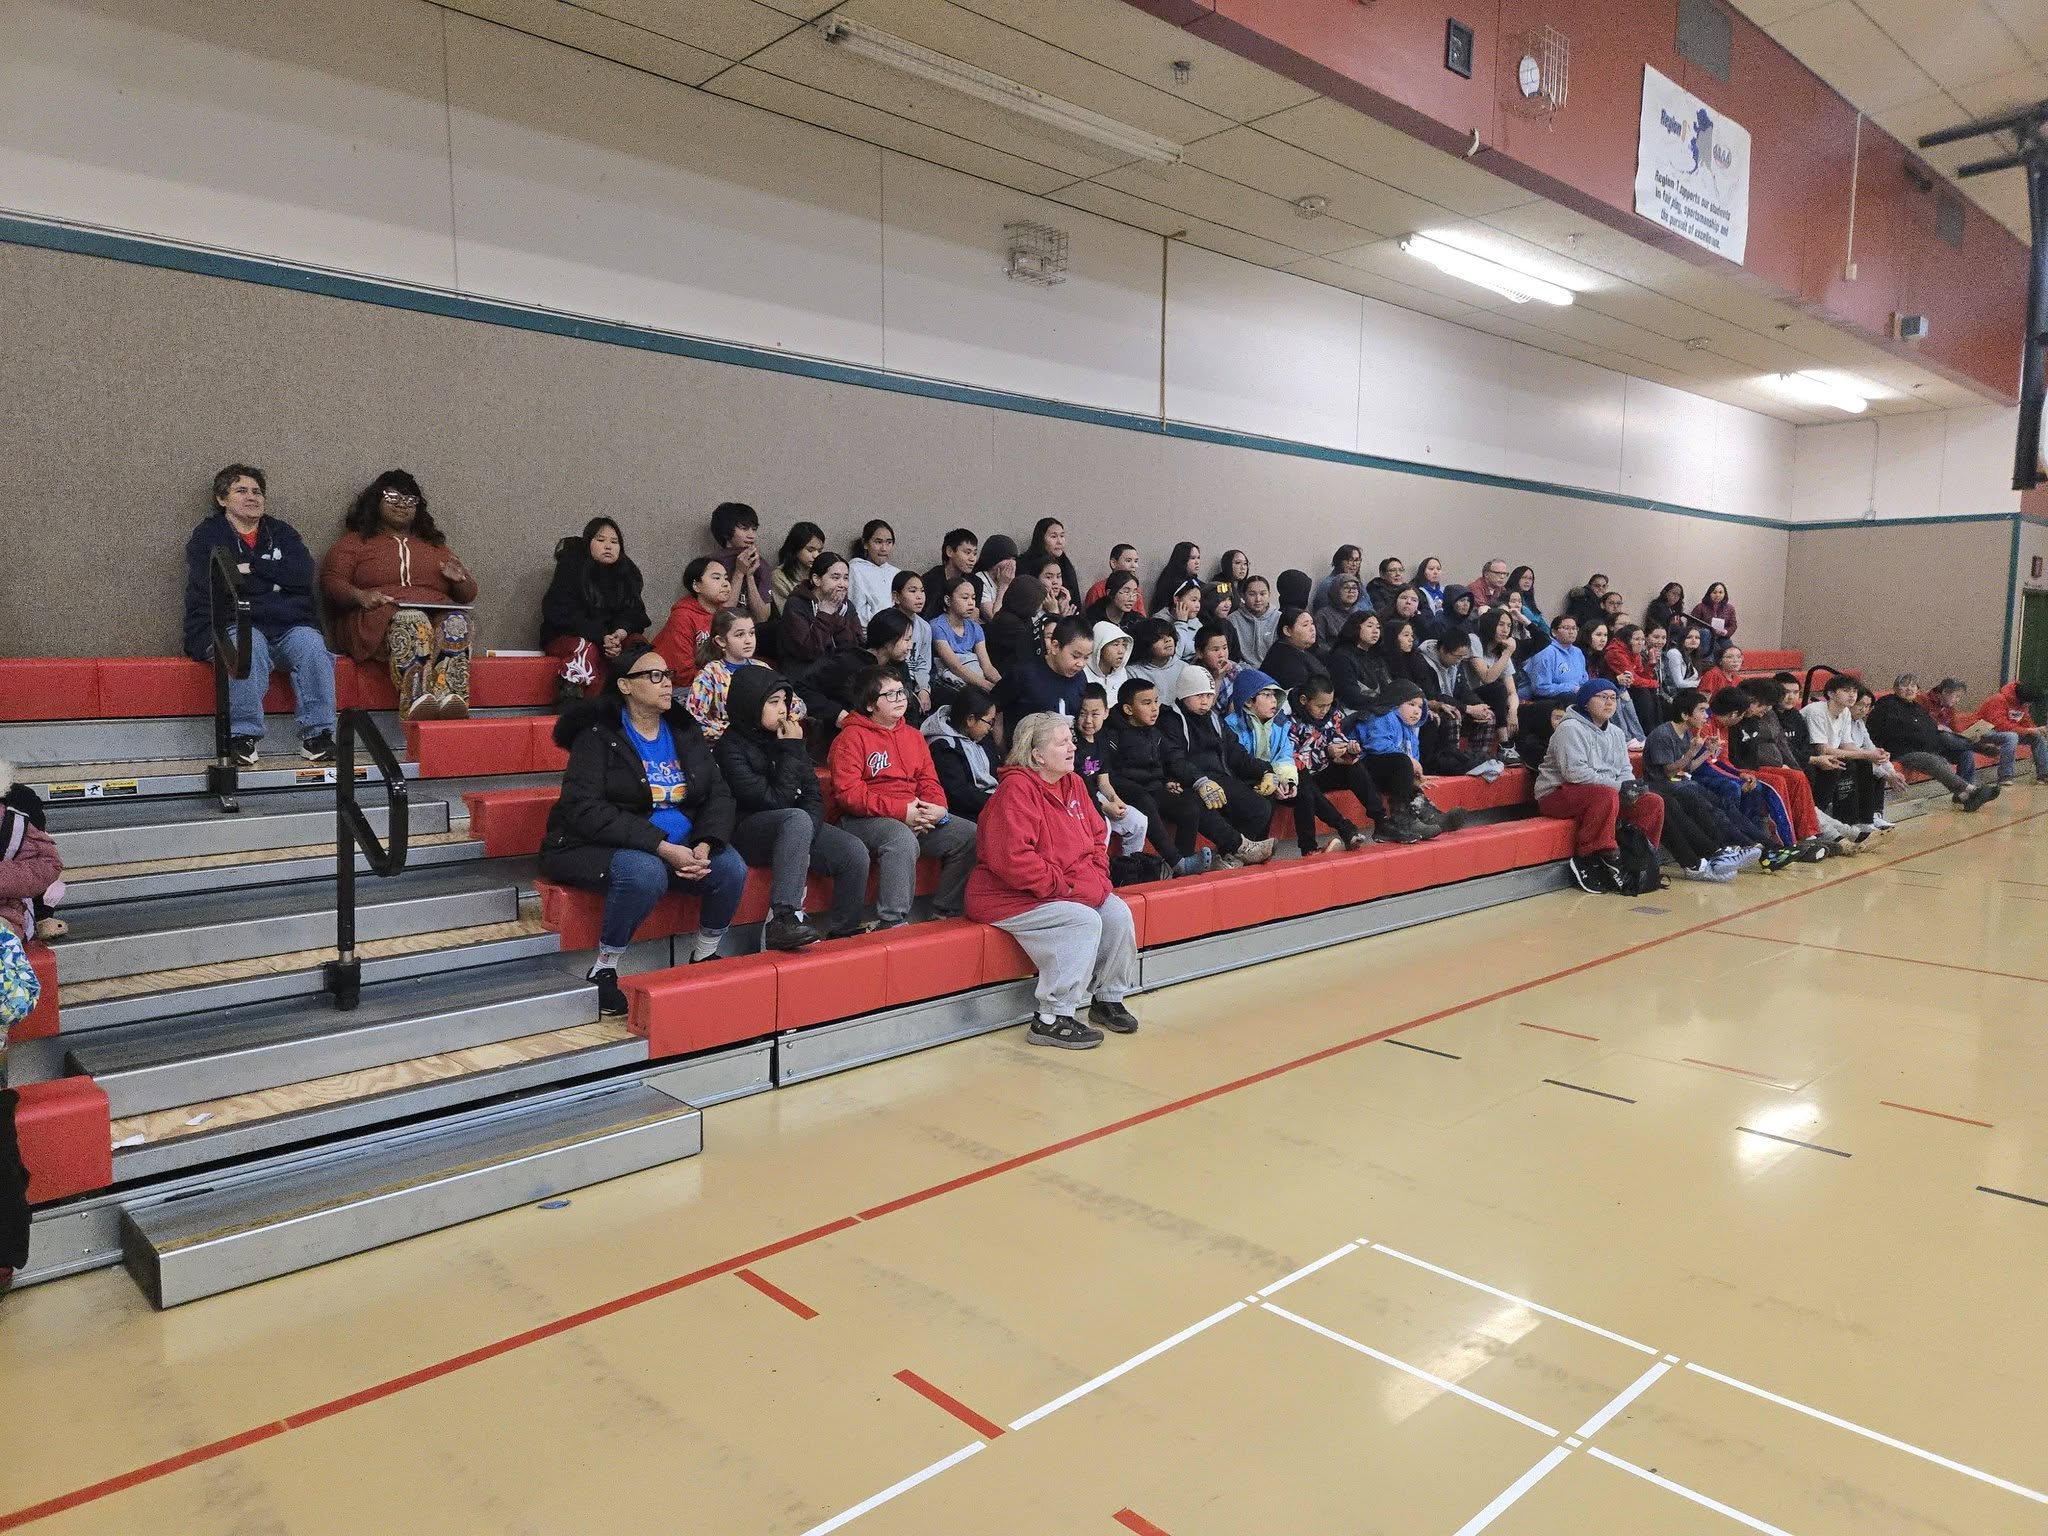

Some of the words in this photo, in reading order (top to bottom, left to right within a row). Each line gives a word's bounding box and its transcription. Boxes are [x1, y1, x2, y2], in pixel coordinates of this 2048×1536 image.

[1660, 108, 1681, 137] Region
[1654, 169, 1674, 189] Region
[1679, 185, 1701, 205] supports
[1701, 198, 1709, 209] our
[1710, 203, 1731, 221] students
[1663, 189, 1671, 205] fair
[1683, 205, 1720, 233] sportsmanship
[1720, 224, 1729, 237] and
[1669, 215, 1687, 232] pursuit
[1688, 224, 1695, 234] of
